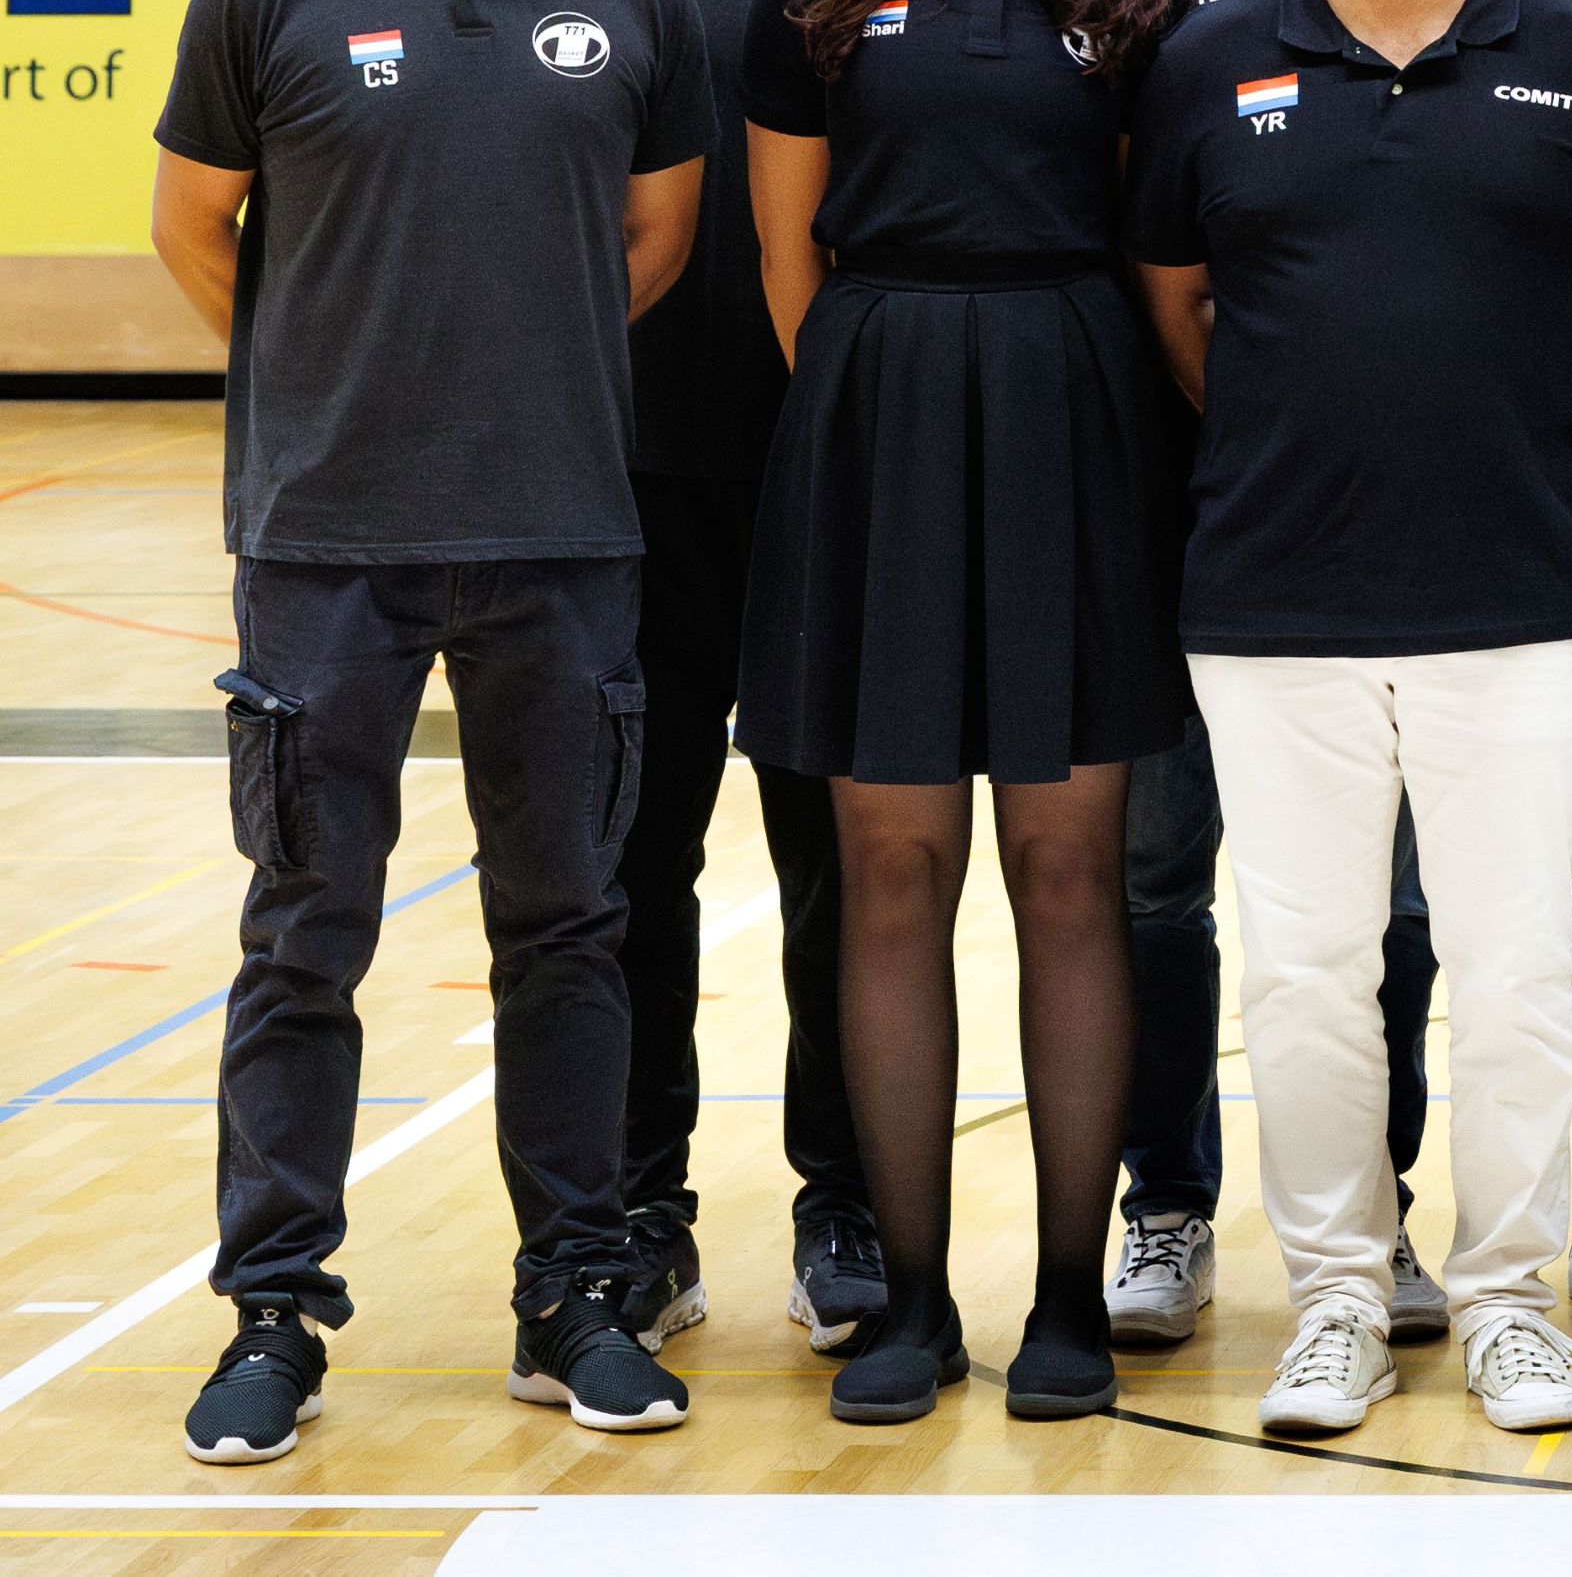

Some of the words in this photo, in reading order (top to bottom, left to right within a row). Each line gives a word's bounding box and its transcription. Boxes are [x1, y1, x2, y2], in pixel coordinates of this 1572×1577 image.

[65, 48, 125, 101] of
[362, 60, 399, 89] CS
[1250, 112, 1287, 136] YR
